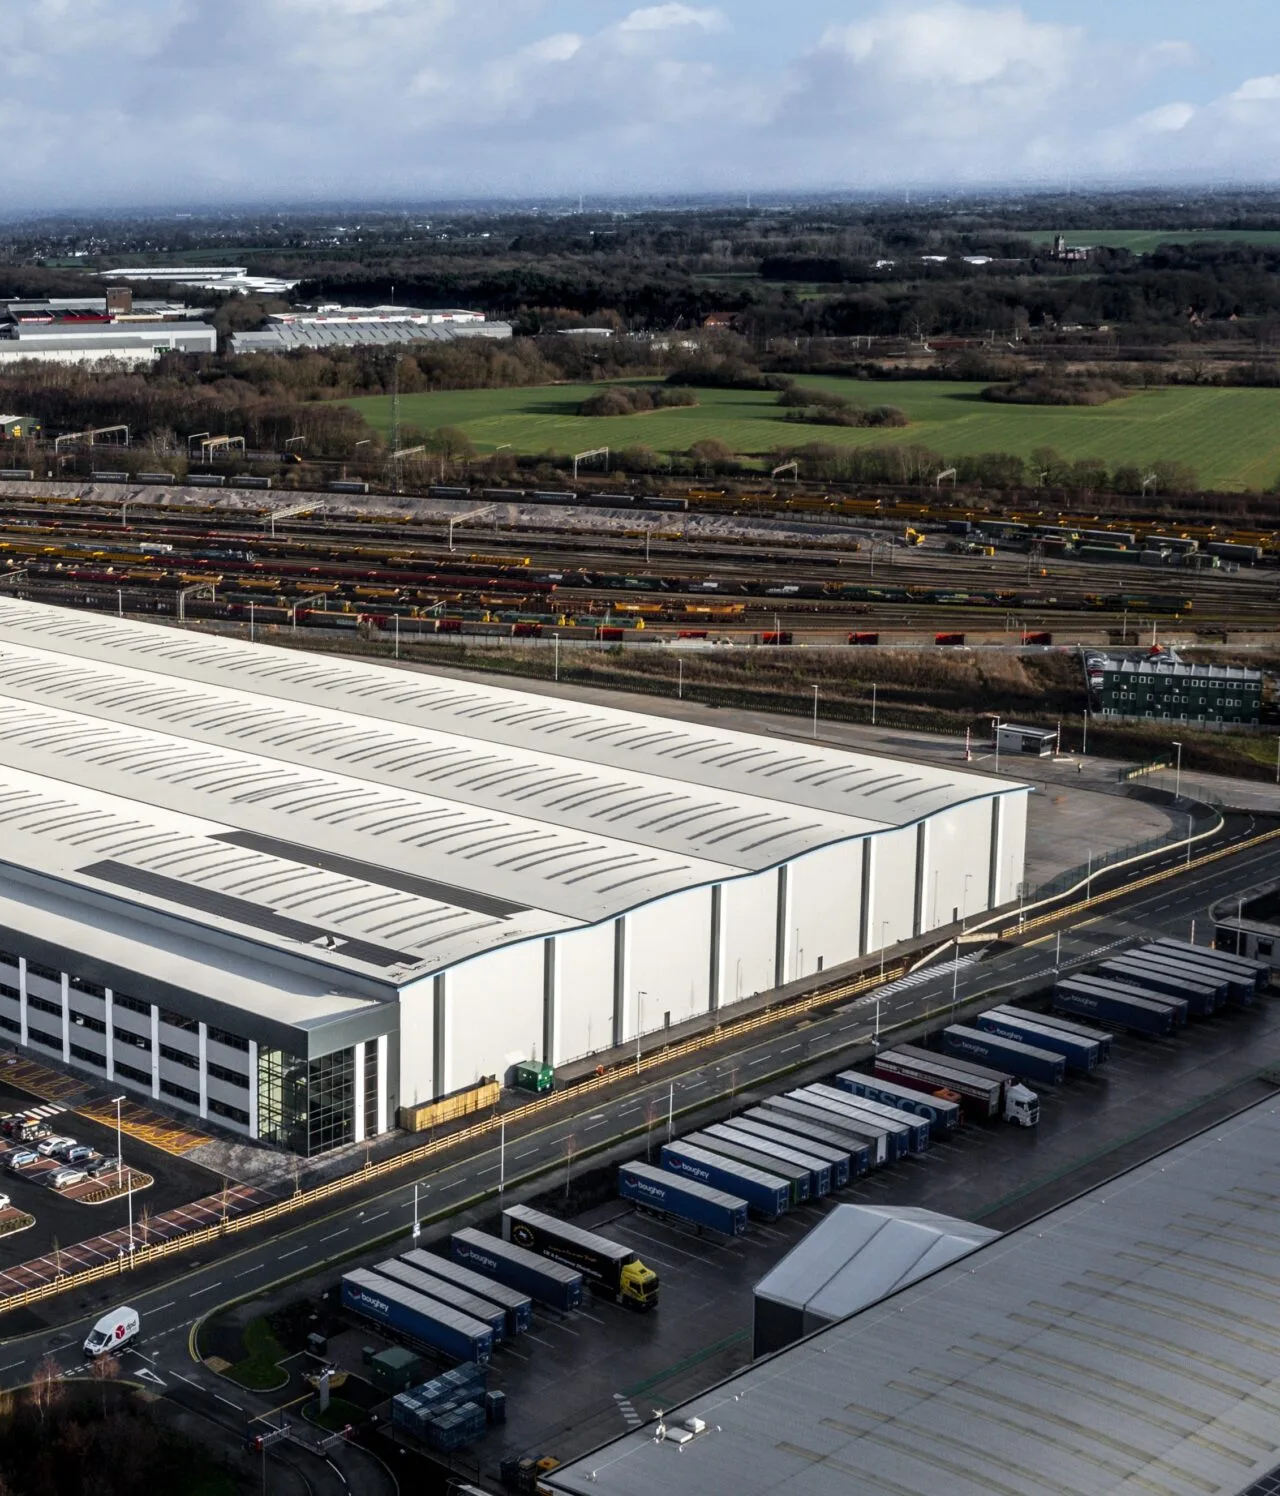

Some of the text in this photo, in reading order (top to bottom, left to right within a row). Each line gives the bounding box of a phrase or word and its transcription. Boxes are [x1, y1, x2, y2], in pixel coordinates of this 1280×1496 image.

[845, 1079, 937, 1124] TESCO
[682, 1163, 709, 1179] boughey
[638, 1181, 666, 1198] boughey
[470, 1250, 497, 1269] boughey
[361, 1292, 389, 1312] boughey
[126, 1320, 137, 1331] dpd
